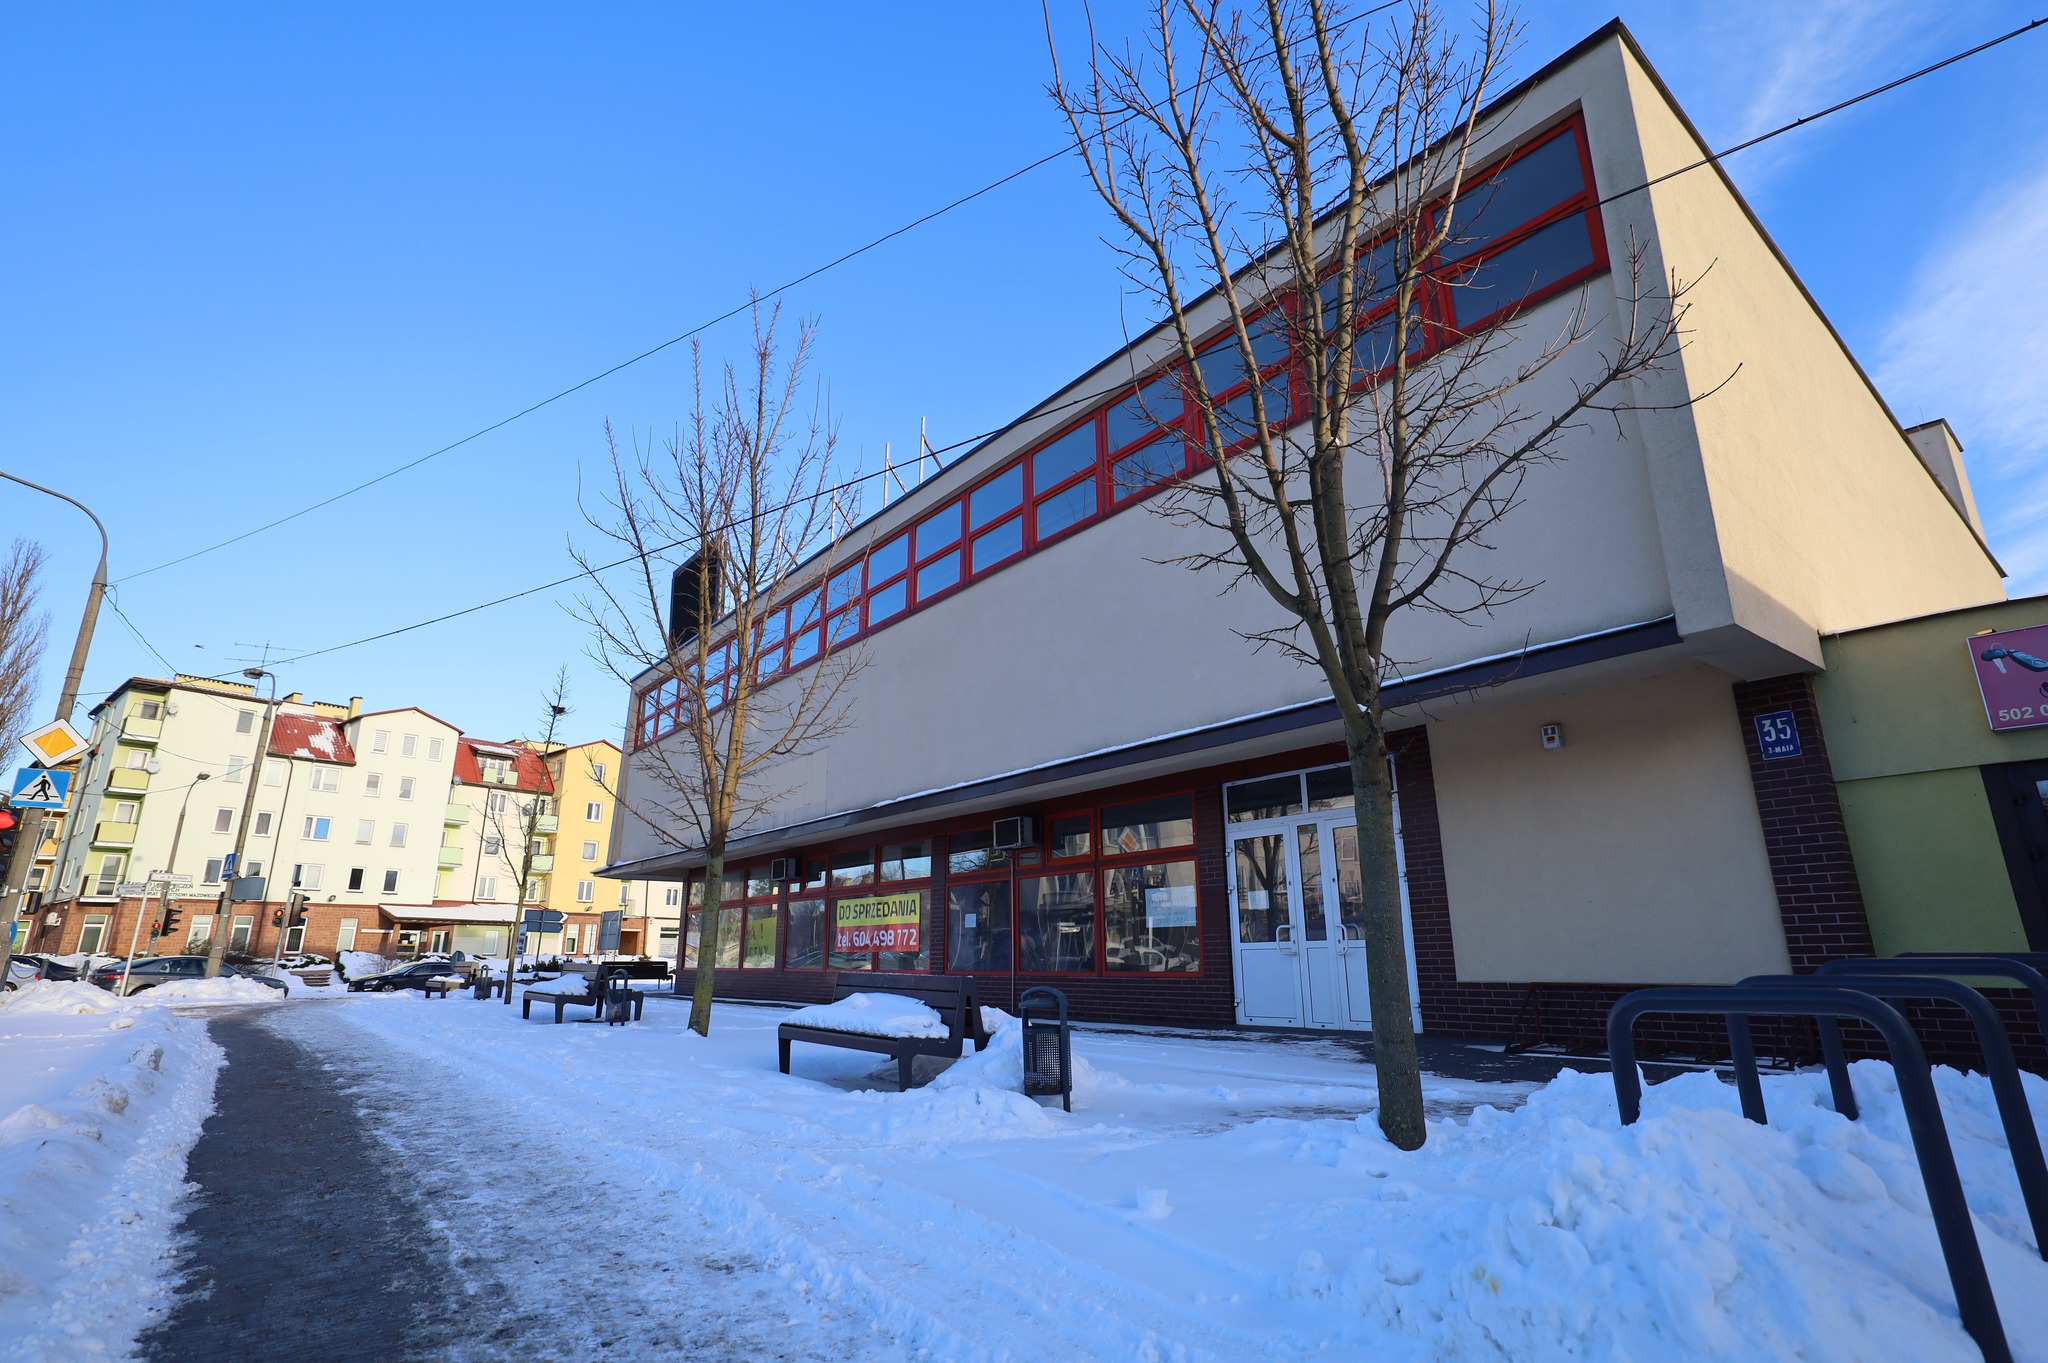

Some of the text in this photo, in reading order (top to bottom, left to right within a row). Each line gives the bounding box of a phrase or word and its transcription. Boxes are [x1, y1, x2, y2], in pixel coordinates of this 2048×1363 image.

[1998, 706, 2034, 722] 502
[1761, 717, 1791, 742] 35
[838, 899, 917, 921] DO SPRZEDANIA
[837, 928, 917, 948] tel. 604 498 772
